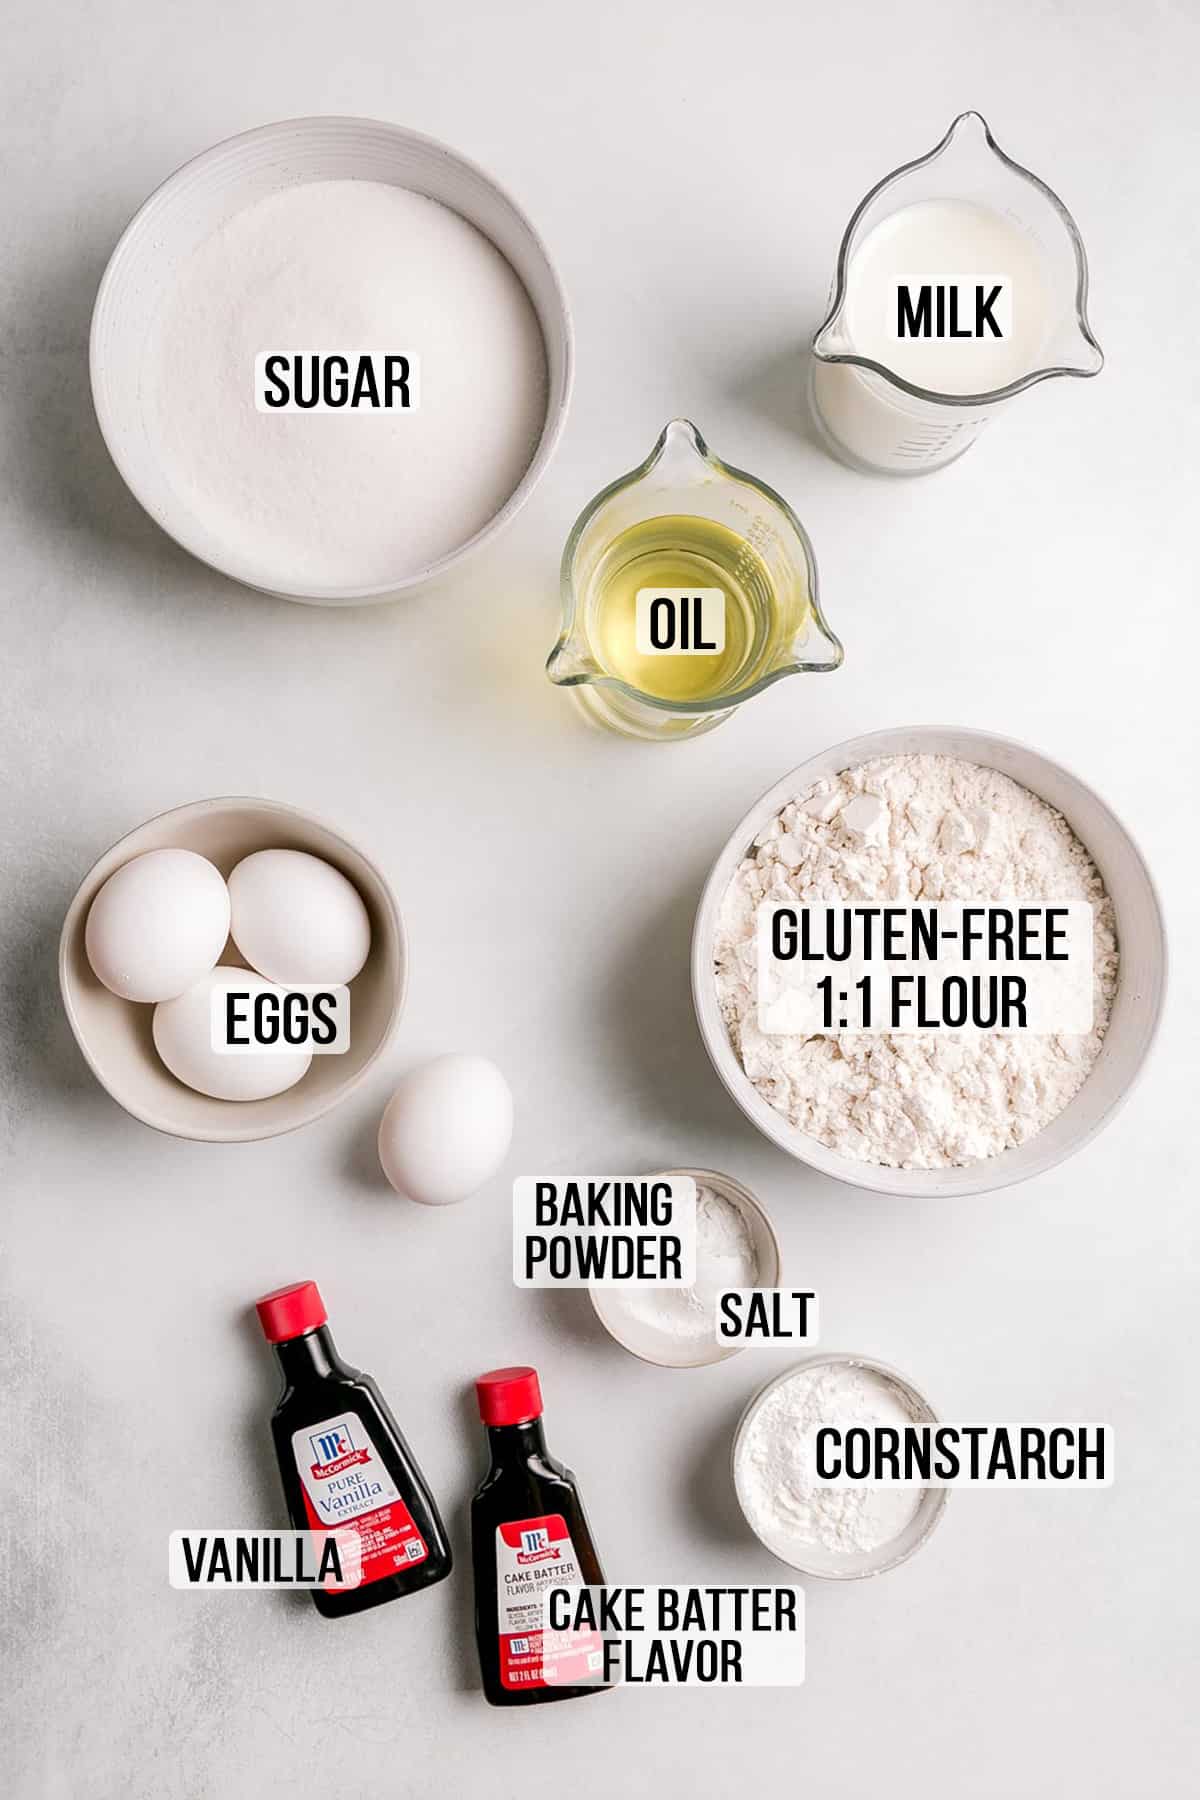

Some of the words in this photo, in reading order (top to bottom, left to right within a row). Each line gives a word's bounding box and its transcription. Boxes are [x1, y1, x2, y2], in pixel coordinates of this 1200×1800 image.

[314, 1453, 366, 1479] McCormick
[328, 1471, 366, 1494] PURE
[319, 1481, 383, 1513] Vanilla
[504, 1569, 533, 1584] CAKE
[534, 1562, 575, 1580] BATTER
[506, 1582, 535, 1596] FLAVOR
